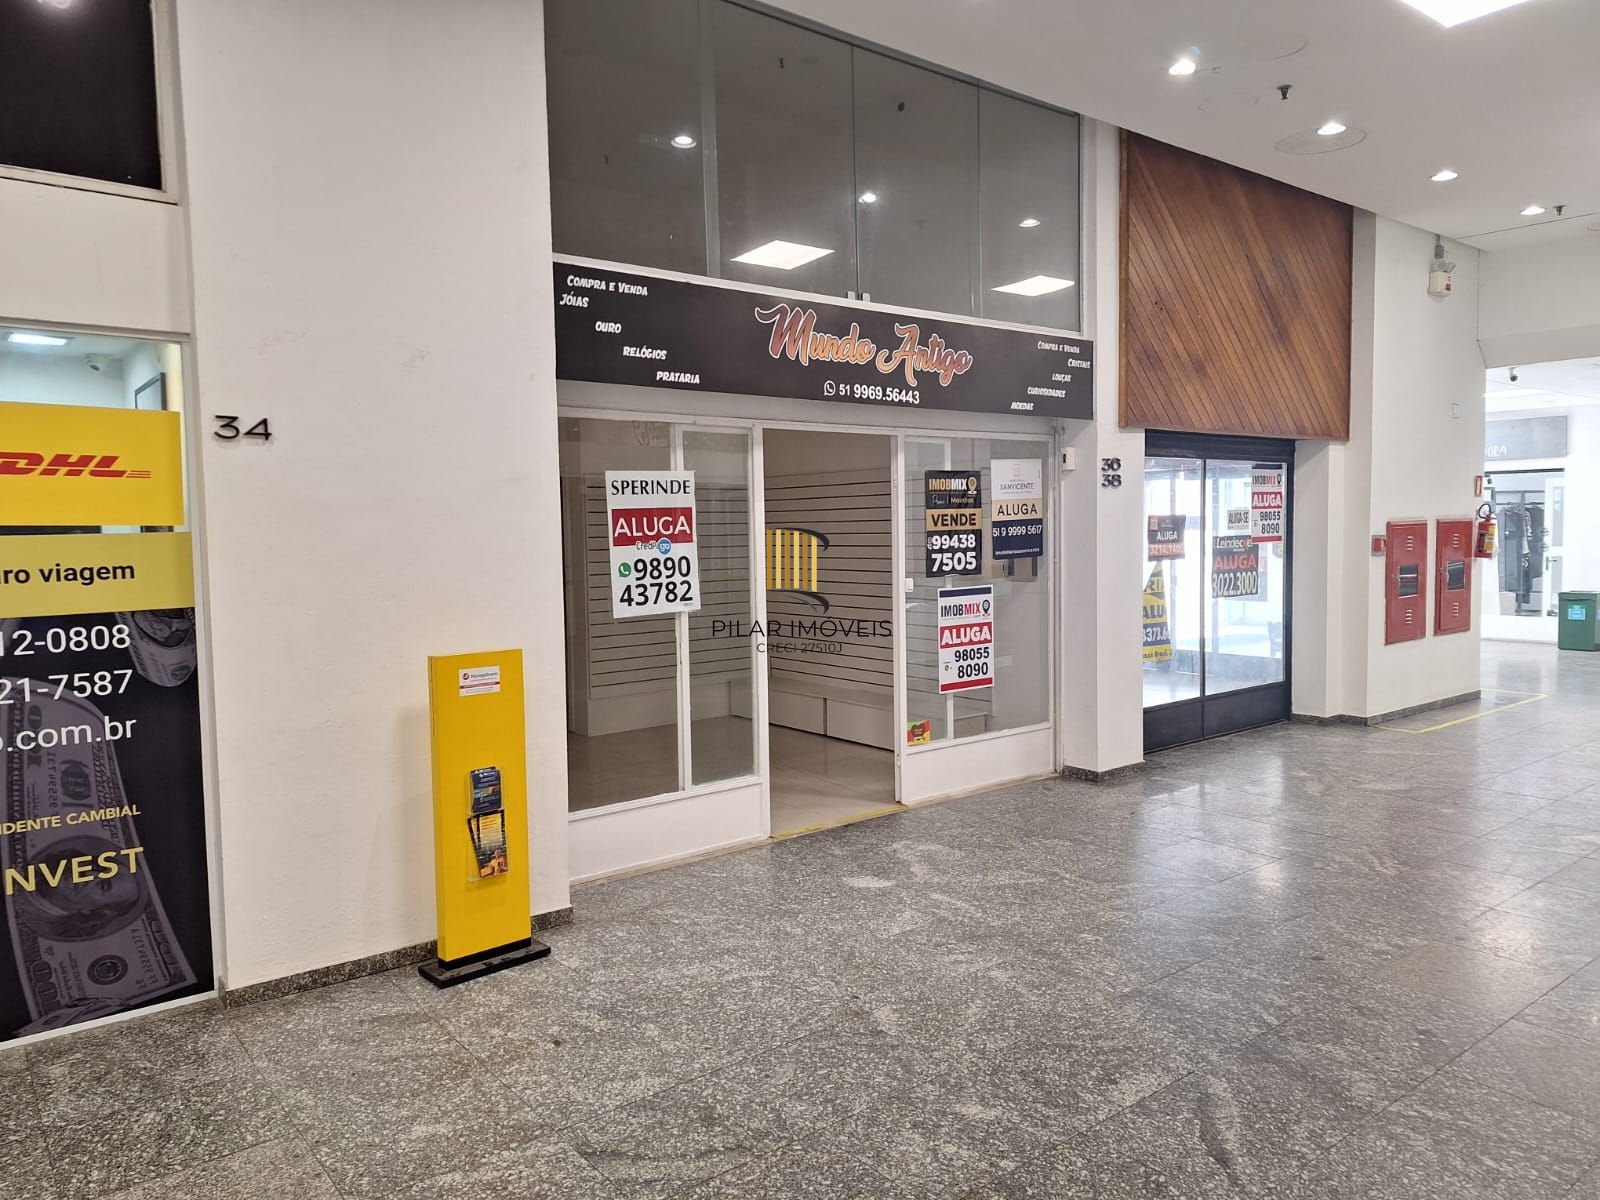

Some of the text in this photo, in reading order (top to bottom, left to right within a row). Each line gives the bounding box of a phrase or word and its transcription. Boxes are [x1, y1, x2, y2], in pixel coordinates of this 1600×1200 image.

[560, 291, 589, 308] JÓIAS
[595, 321, 622, 333] OURO
[623, 345, 667, 360] RELÓGIOS
[755, 304, 973, 387] Mundo Antigo
[656, 371, 700, 384] PRATARIA
[839, 384, 920, 404] 51 9969.56443
[214, 415, 272, 441] 34
[0, 452, 128, 478] DHL
[1101, 458, 1121, 472] 36
[611, 479, 690, 496] SPERINDE
[929, 478, 967, 490] IMOBMIX
[1101, 473, 1122, 487] 38
[1252, 493, 1281, 506] ALUGA
[997, 503, 1038, 516] ALUGA
[1260, 511, 1280, 521] 98055
[614, 515, 690, 537] ALUGA
[931, 512, 976, 527] VENDE
[993, 528, 1000, 537] 51
[1001, 527, 1006, 536] 9
[1156, 530, 1178, 540] ALUGA
[1261, 523, 1279, 534] 8090
[932, 534, 976, 550] 99438
[633, 556, 691, 581] 9890
[931, 551, 976, 571] 7505
[1215, 555, 1256, 571] ALUGA
[0, 563, 135, 586] ro viagem
[620, 580, 693, 607] 43782
[941, 602, 981, 617] IMOBMIX
[1143, 604, 1167, 620] ALU
[941, 625, 992, 646] ALUGA
[954, 646, 990, 662] 98055
[957, 662, 989, 679] 8090
[0, 669, 134, 704] 21-7587
[0, 716, 137, 752] .com.br
[66, 804, 142, 825] CAMBIAL
[4, 847, 144, 896] NVEST
